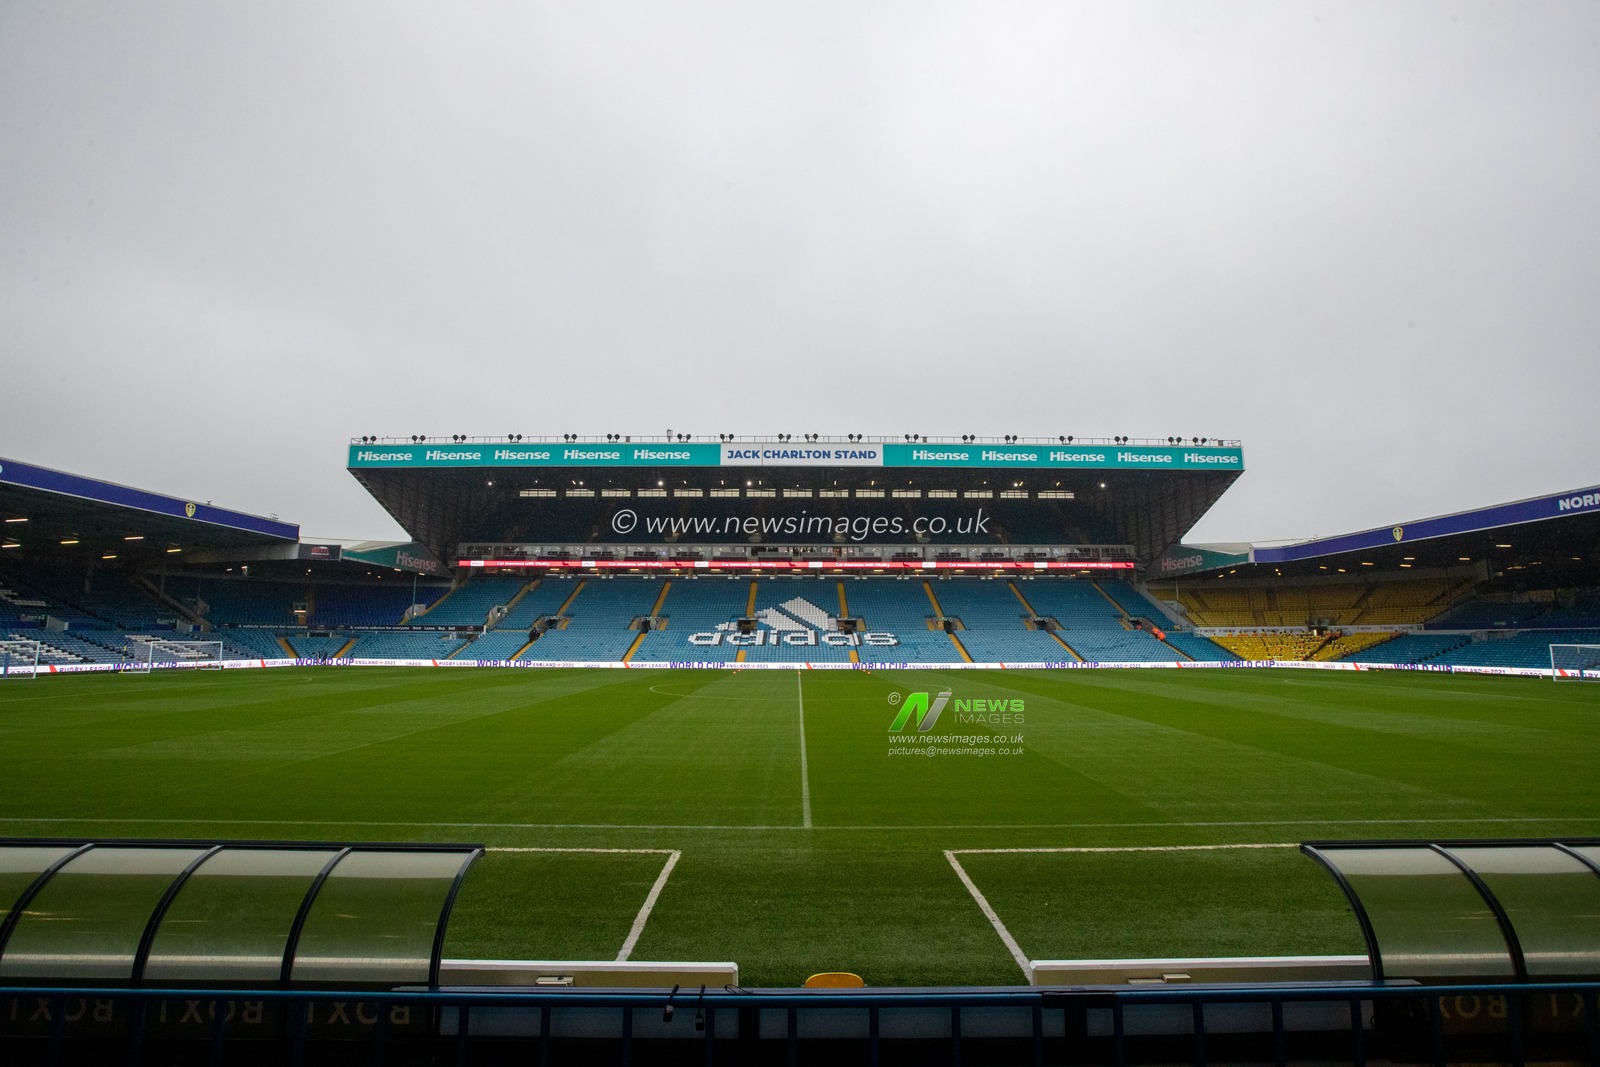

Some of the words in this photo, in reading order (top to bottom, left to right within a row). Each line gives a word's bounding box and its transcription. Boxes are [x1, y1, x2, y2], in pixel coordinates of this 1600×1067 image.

[357, 451, 413, 461] Hisense
[425, 450, 482, 461] Hisense
[494, 450, 550, 460] Hisense
[563, 450, 620, 460] Hisense
[633, 449, 691, 460] Hisense
[727, 449, 761, 460] JACK
[763, 449, 831, 460] CHARLTON
[834, 449, 877, 460] STAND
[912, 450, 970, 461] Hisense
[981, 450, 1038, 461] Hisense
[1049, 451, 1106, 462] Hisense
[1117, 452, 1173, 463] Hisense
[1184, 452, 1239, 464] Hisense
[396, 551, 437, 572] Hisense
[1161, 554, 1203, 572] Hisense
[687, 630, 900, 647] adidas
[336, 658, 355, 666] CUP
[669, 661, 704, 669] WORLD
[706, 661, 726, 669] CUP
